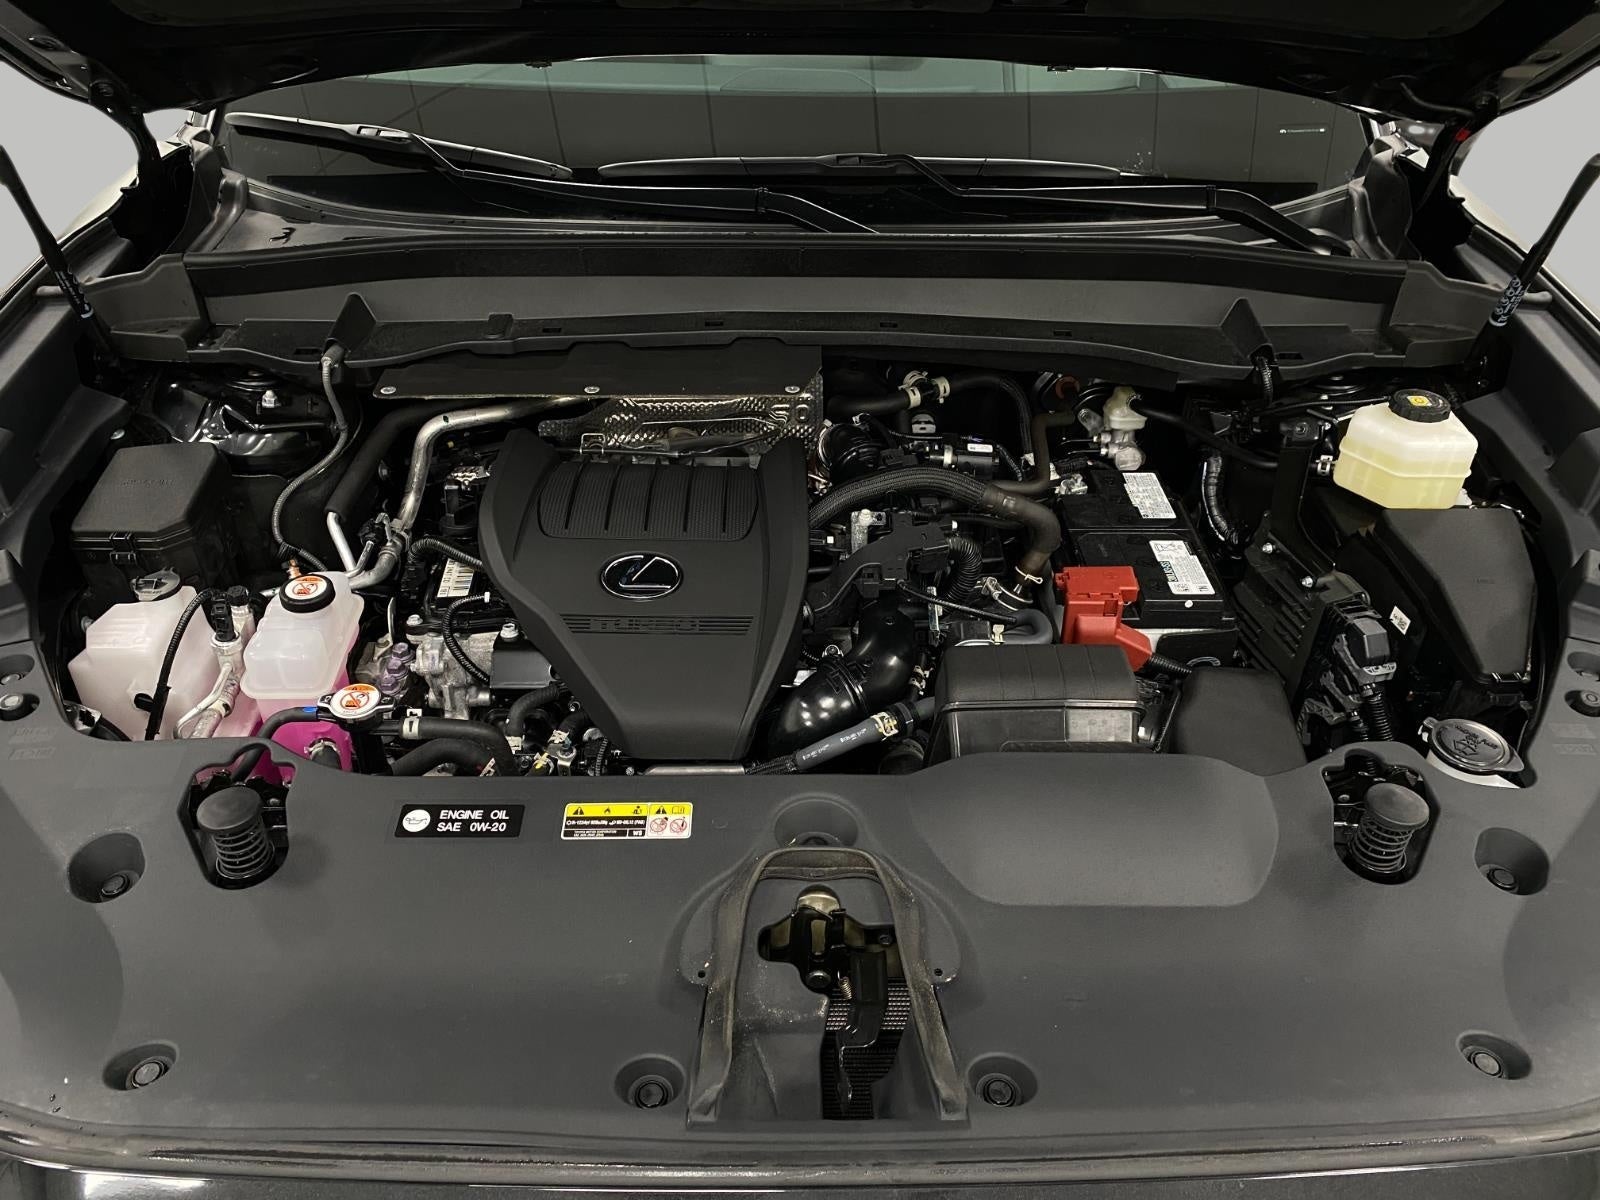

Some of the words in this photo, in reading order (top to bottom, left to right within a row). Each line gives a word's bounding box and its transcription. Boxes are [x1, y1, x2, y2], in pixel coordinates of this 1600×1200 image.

[591, 617, 700, 633] TURBO
[439, 809, 484, 820] ENGINE
[490, 809, 510, 820] OIL
[436, 821, 462, 832] SAE
[469, 821, 507, 832] 0W-20
